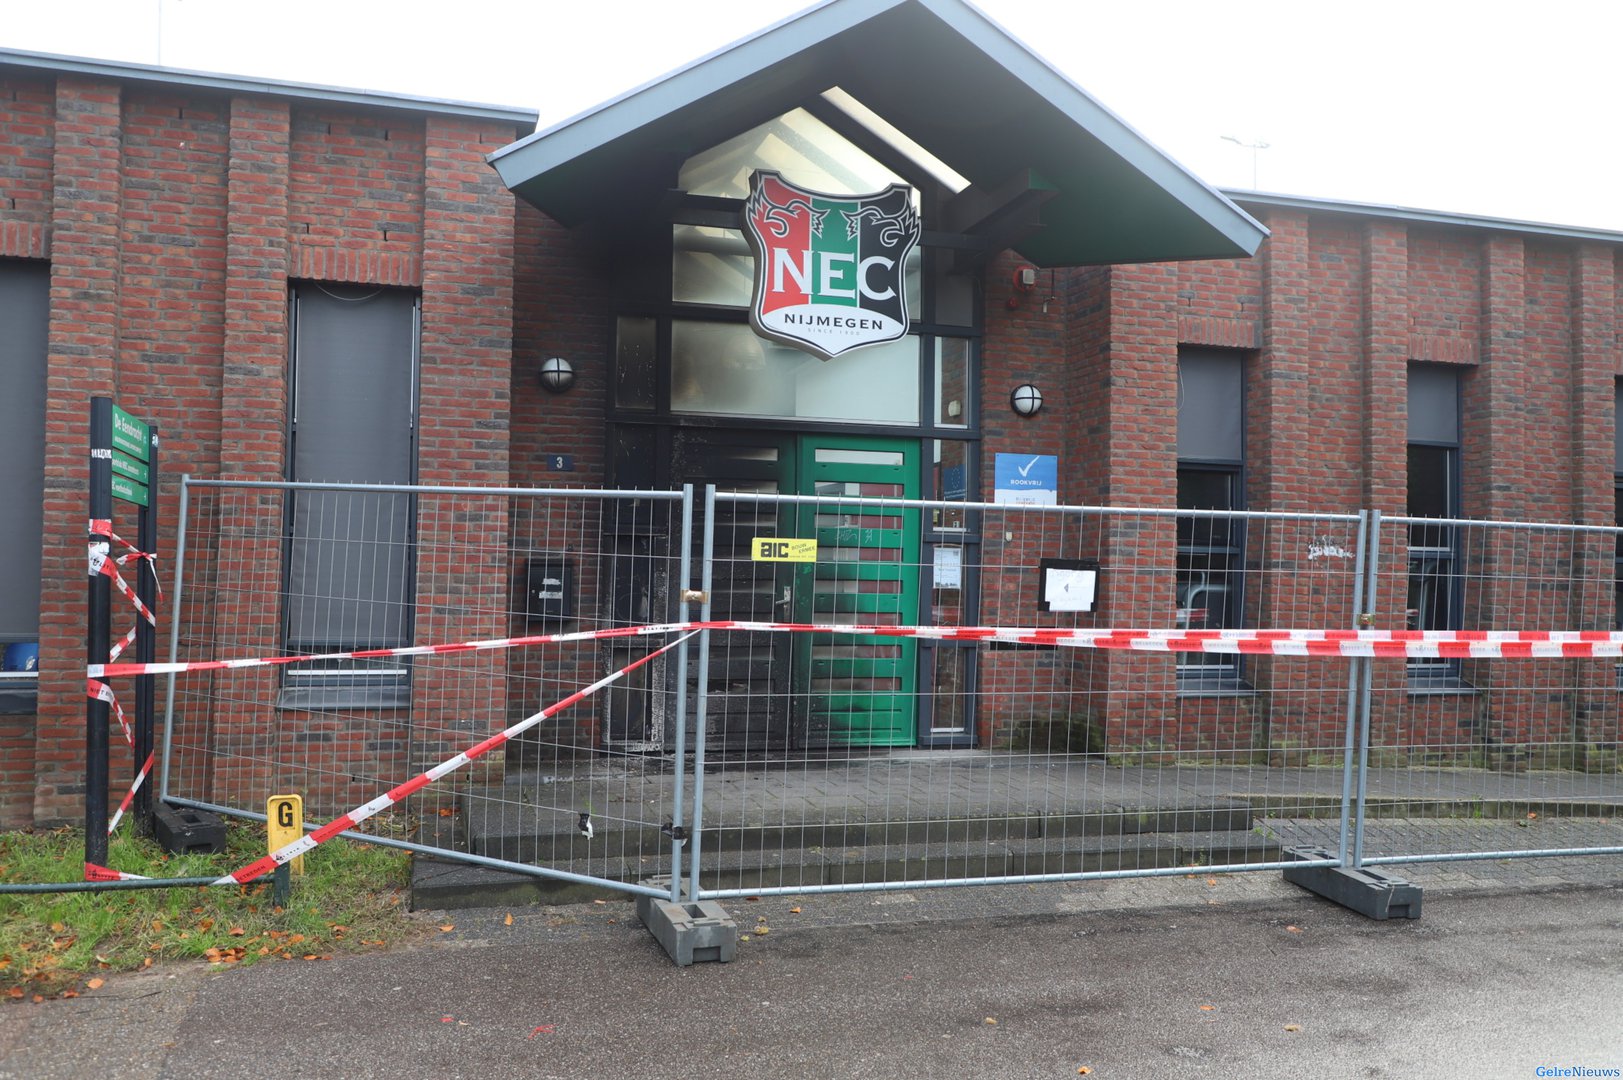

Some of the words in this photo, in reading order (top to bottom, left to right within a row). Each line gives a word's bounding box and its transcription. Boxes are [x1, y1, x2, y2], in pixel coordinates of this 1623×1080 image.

[772, 247, 897, 301] NEC
[784, 313, 883, 330] NIJMEGEN
[556, 456, 563, 469] 3
[278, 801, 293, 827] G
